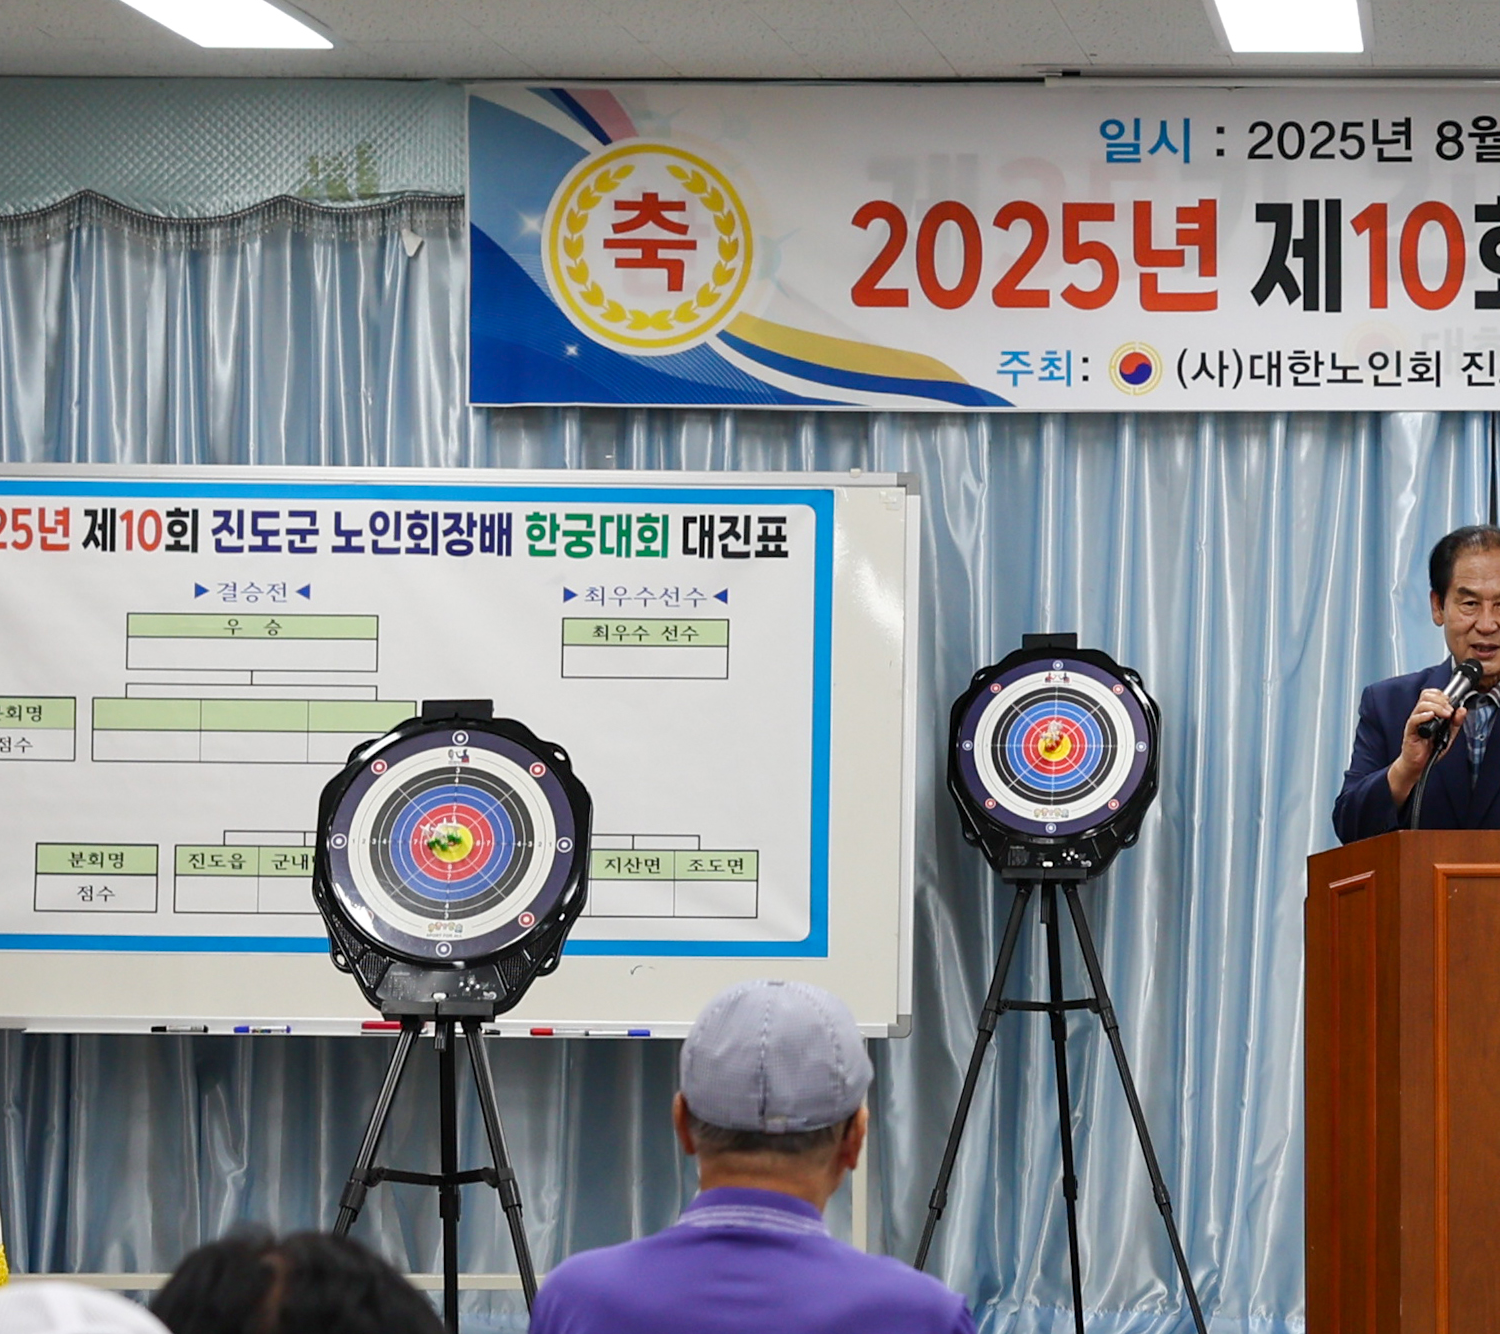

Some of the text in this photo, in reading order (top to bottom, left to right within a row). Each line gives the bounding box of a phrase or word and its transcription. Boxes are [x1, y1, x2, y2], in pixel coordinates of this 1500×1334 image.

[1099, 117, 1191, 164] 일시
[1216, 126, 1225, 157] :
[1247, 116, 1413, 163] 2025년
[602, 191, 697, 293] 축
[851, 198, 1218, 312] 2025년
[996, 350, 1089, 387] 주최:
[1177, 348, 1441, 390] (사)대한노인회
[81, 507, 199, 554] 제10회
[210, 508, 320, 555] 진도군
[331, 509, 513, 558] 노인회장배
[525, 511, 670, 559] 한궁대회
[681, 514, 789, 560] 대진표
[217, 581, 287, 603] 결승전
[585, 585, 707, 609] 최우수선수
[592, 624, 699, 643] 최우수 선수
[67, 851, 744, 875] 분회명 진도읍 군내 지산면 조도면
[77, 884, 115, 903] 점수
